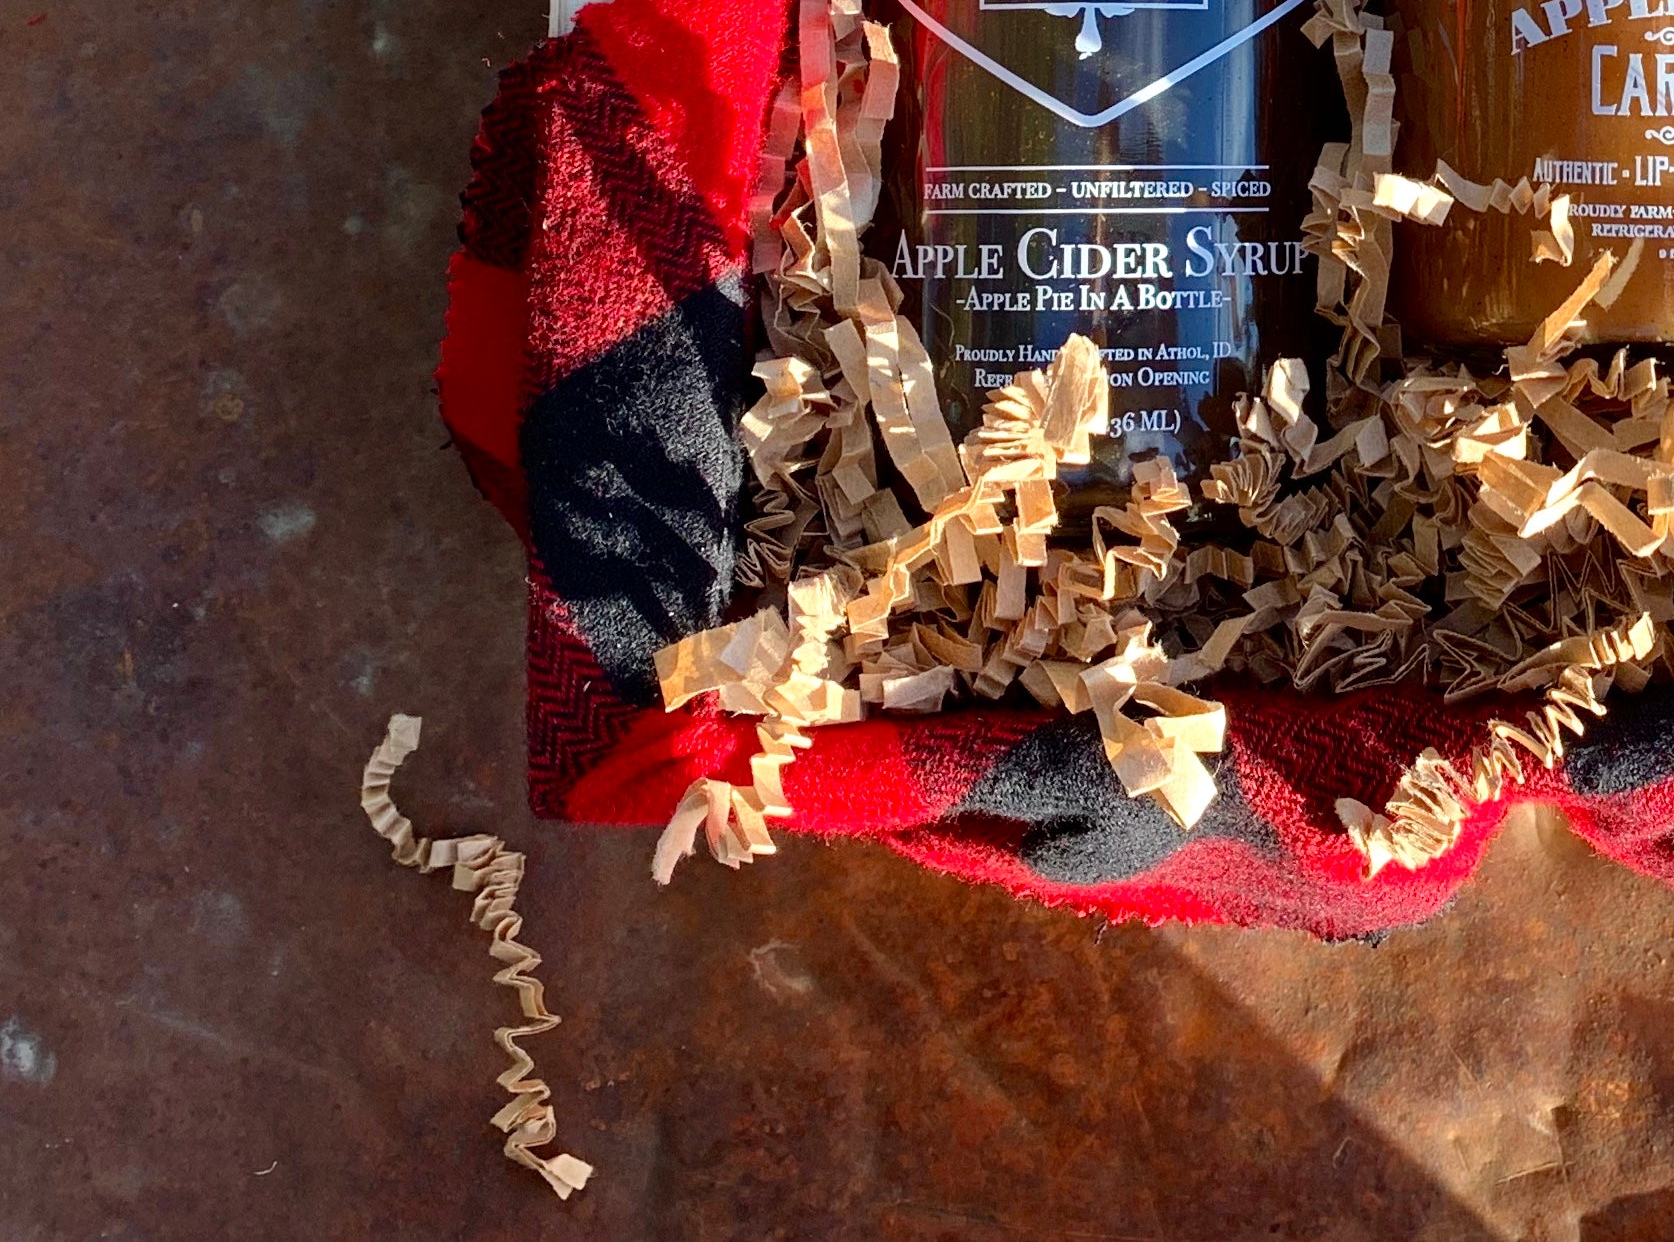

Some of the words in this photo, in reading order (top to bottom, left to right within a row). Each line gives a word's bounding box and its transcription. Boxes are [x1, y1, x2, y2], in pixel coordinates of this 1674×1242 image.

[1532, 157, 1618, 185] AUTHENTIC
[924, 182, 965, 200] FARM
[968, 181, 1051, 200] CRAFTED
[1072, 180, 1193, 199] UNFILTERED
[1211, 180, 1271, 199] SPICED
[1568, 204, 1627, 218] ROUDLY
[892, 229, 1003, 280] APPLE
[1017, 227, 1172, 280] CIDER
[1036, 286, 1074, 311] PIE
[1079, 285, 1106, 310] IN
[1110, 285, 1134, 311] A
[955, 344, 1016, 363] PROUDLY
[1138, 347, 1153, 361] IN
[1155, 343, 1209, 362] ATHOL,
[1212, 341, 1231, 358] ID
[1138, 366, 1210, 387] OPENING
[1140, 409, 1182, 435] ML)
